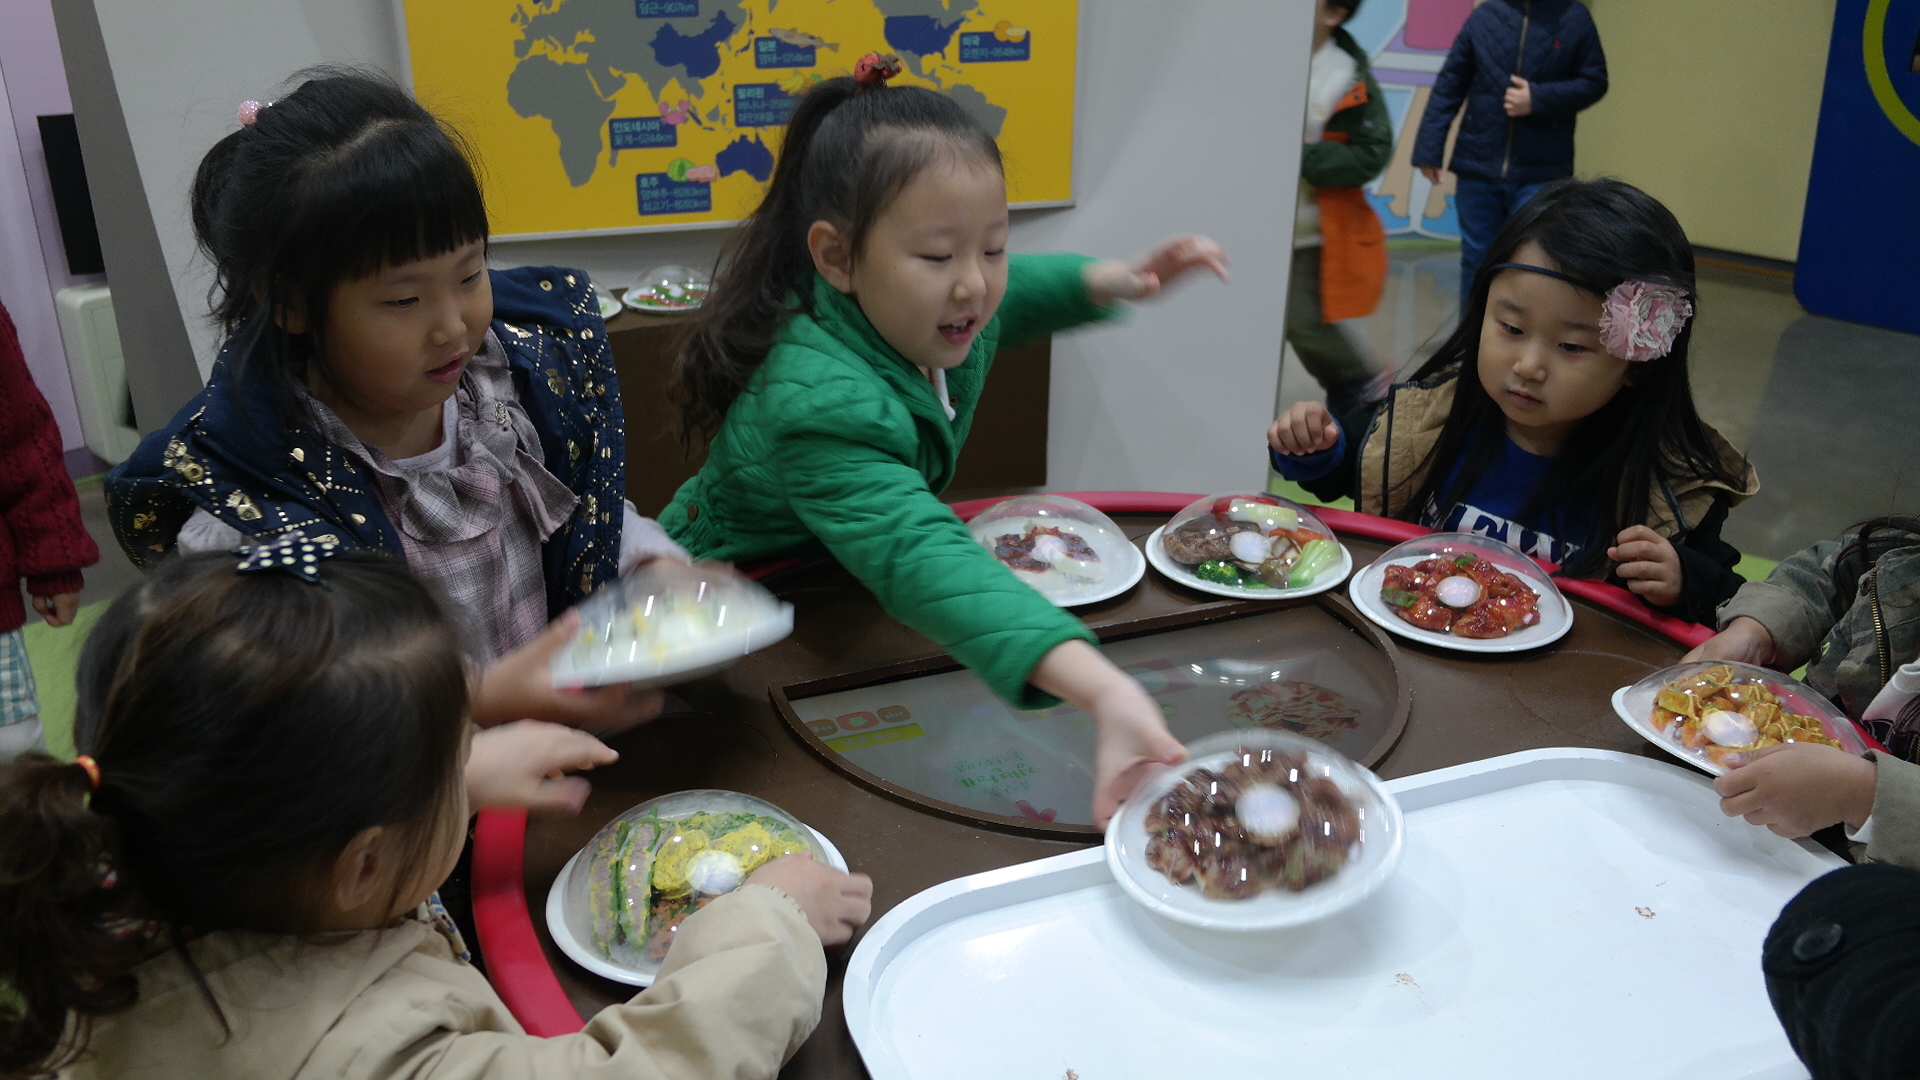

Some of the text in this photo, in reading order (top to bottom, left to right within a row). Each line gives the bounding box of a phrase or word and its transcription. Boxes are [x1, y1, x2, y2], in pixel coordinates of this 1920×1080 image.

[758, 40, 777, 53] 일본
[962, 35, 980, 47] 미국
[737, 86, 765, 100] 필리핀
[612, 119, 660, 134] 인도네시아
